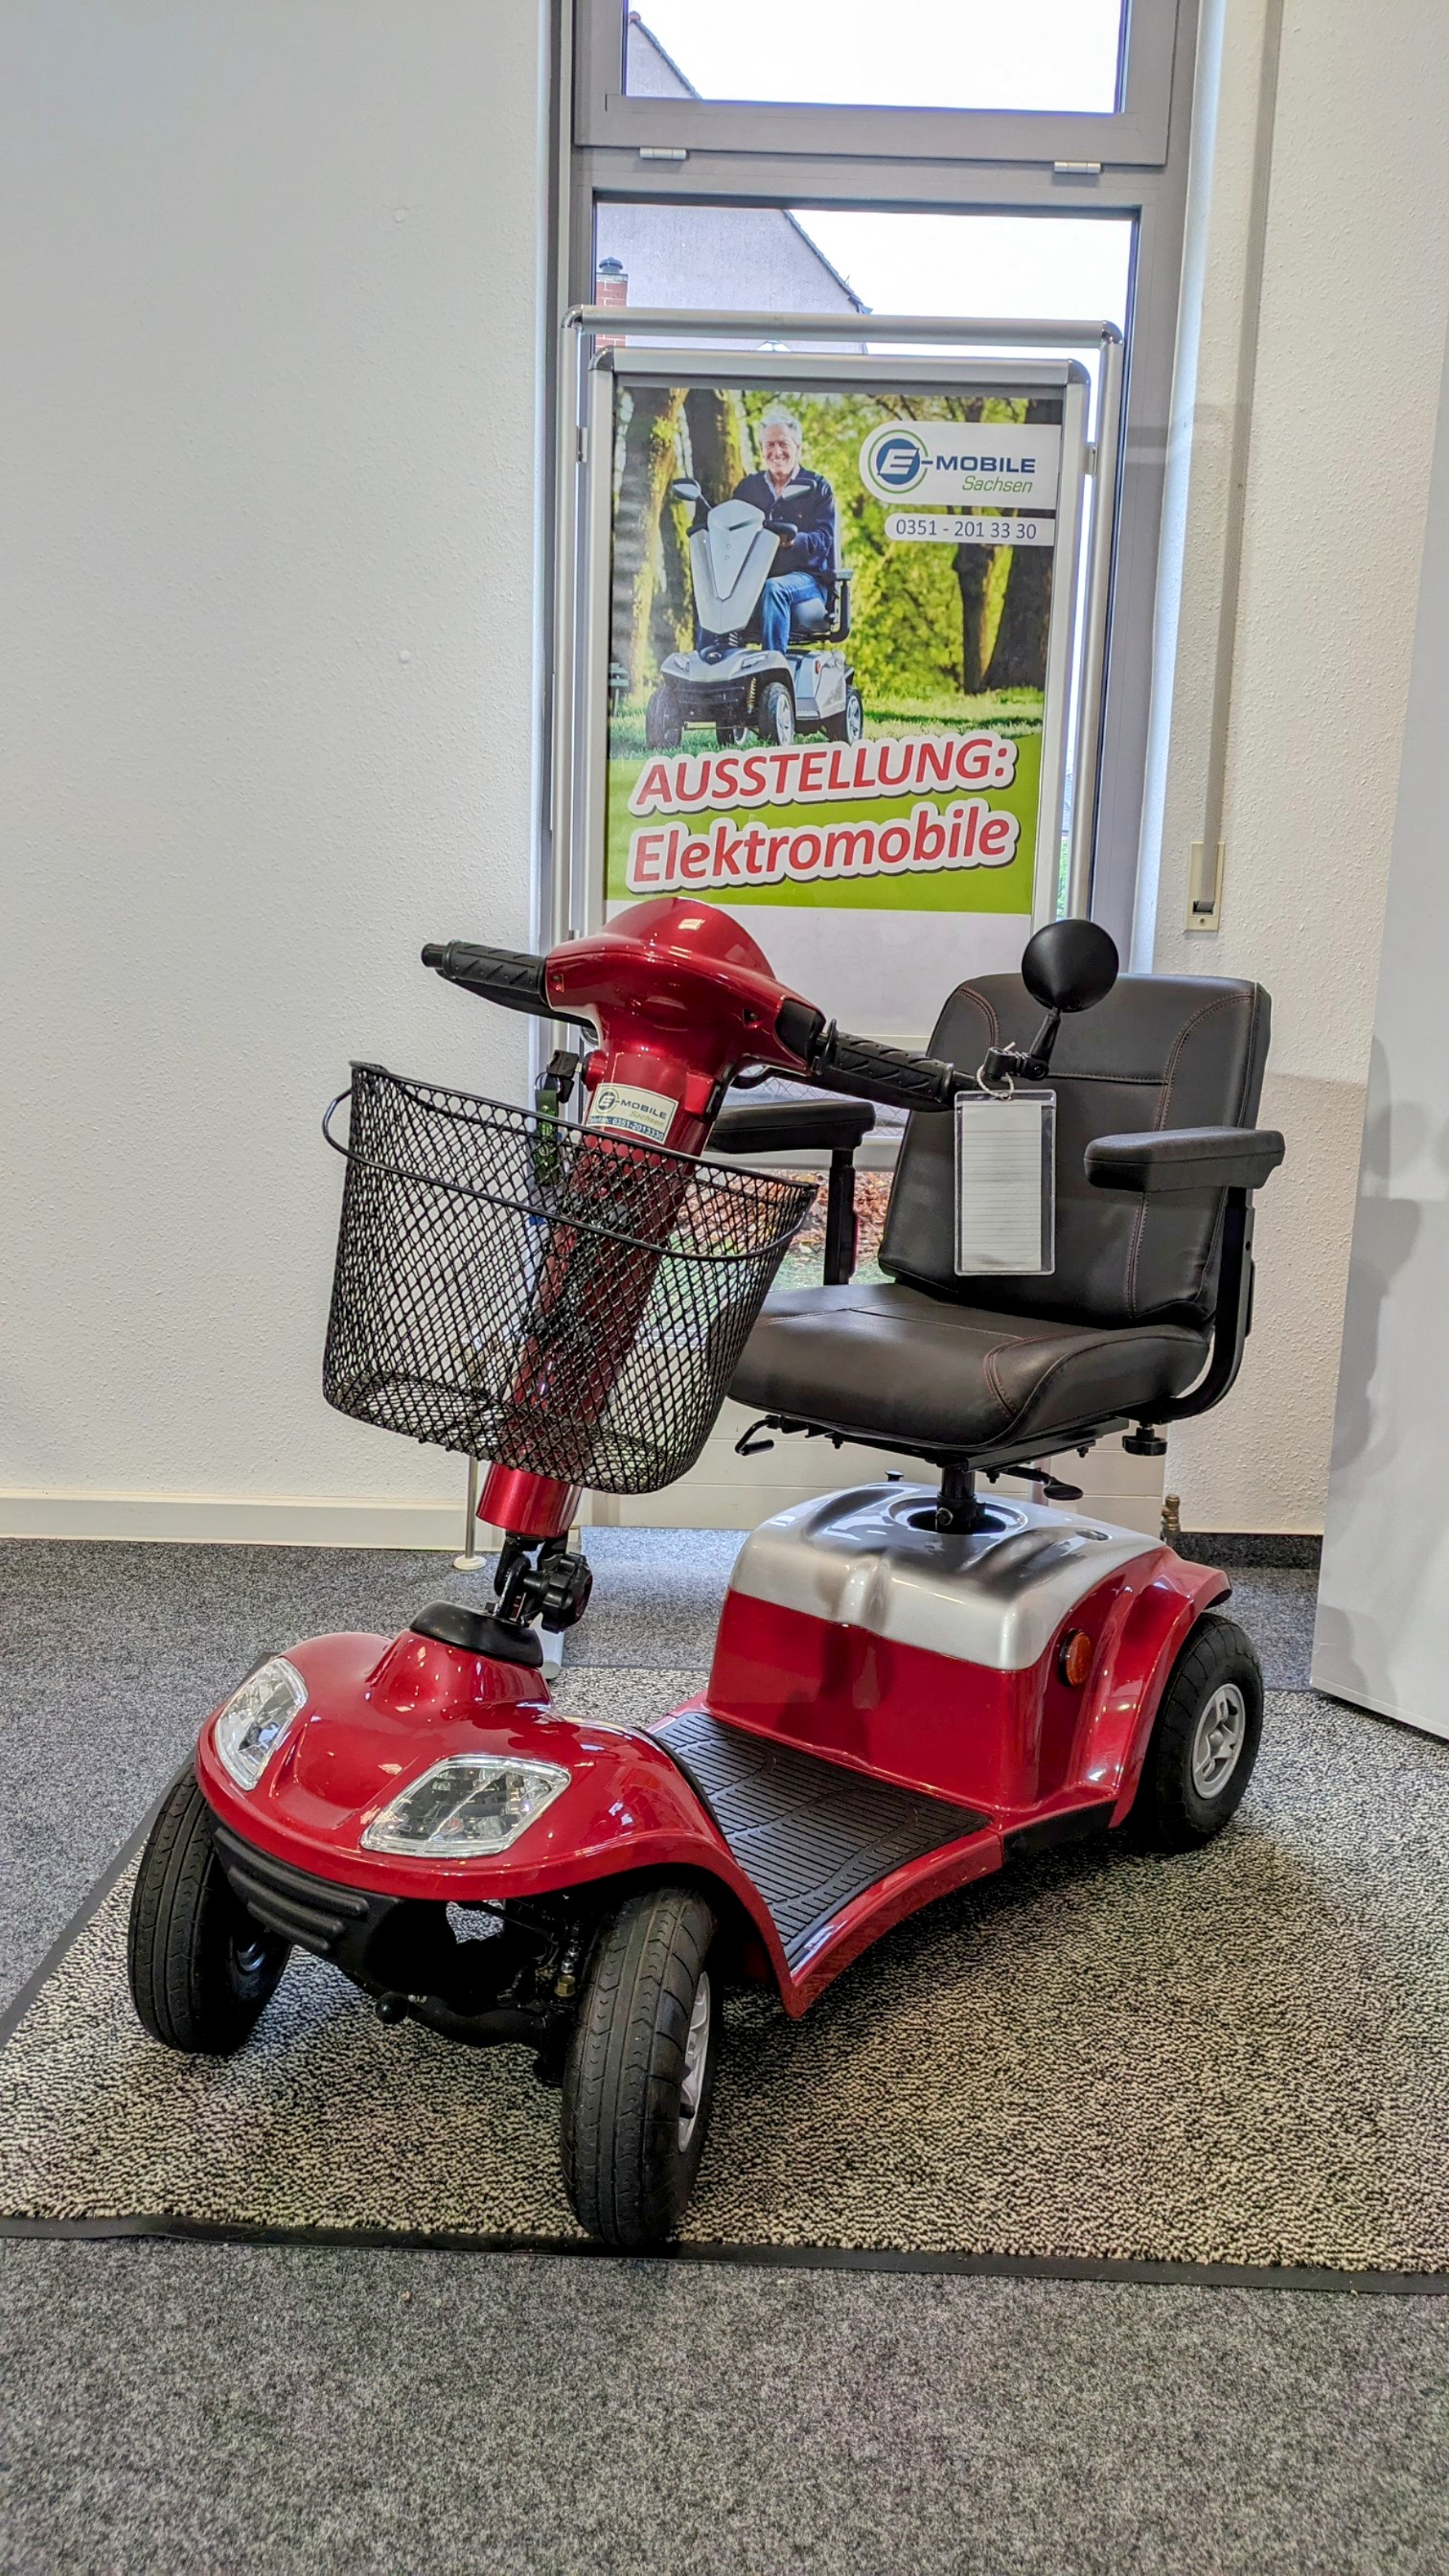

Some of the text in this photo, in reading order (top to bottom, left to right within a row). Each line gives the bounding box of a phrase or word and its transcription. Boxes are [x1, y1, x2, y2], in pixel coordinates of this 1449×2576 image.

[962, 475, 1033, 494] Sachsen
[896, 519, 937, 536] 0351
[954, 521, 984, 537] 201
[991, 522, 1010, 539] 33
[1016, 524, 1037, 540] 30
[636, 738, 1007, 805] AUSSTELLUNG:
[633, 806, 1010, 882] Elektromobile
[612, 1117, 663, 1140] 0351-2013330
[630, 1111, 664, 1127] Sachsen
